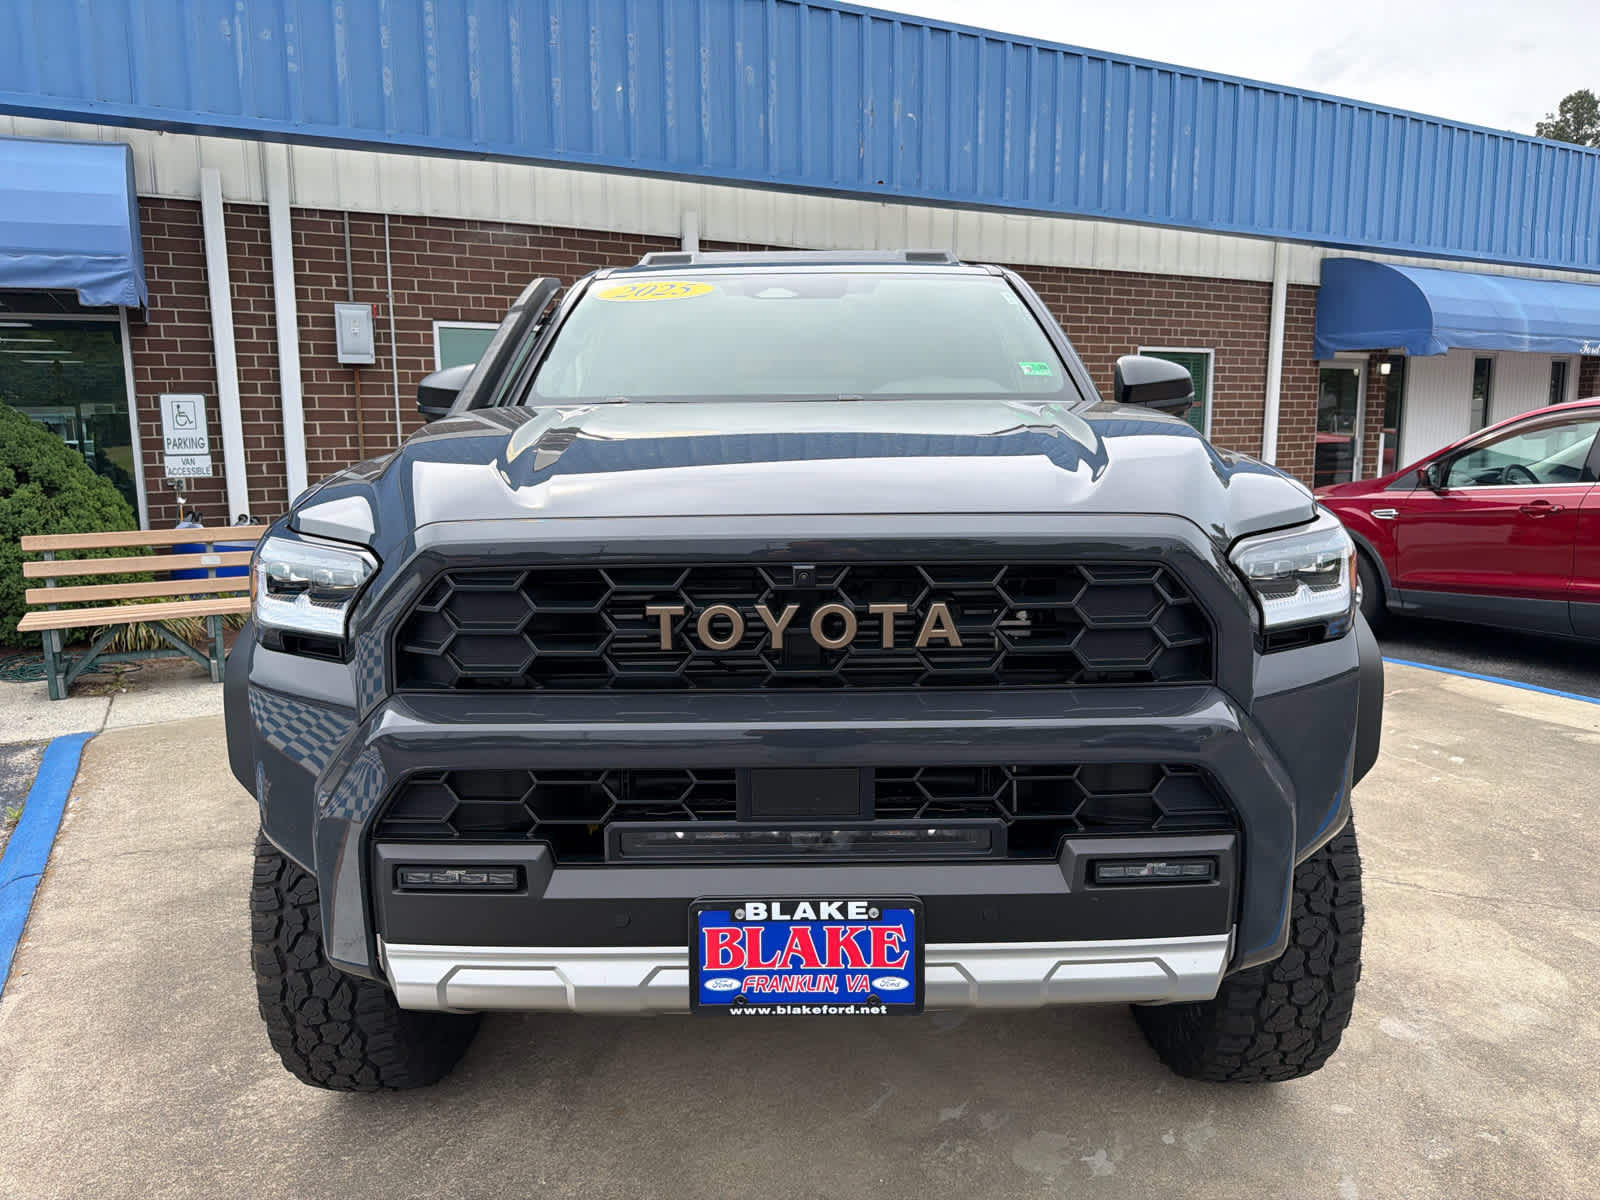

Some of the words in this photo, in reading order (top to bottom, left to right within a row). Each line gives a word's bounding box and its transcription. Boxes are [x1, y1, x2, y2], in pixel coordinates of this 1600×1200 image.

[615, 284, 694, 299] 2025
[166, 437, 206, 449] PARKING
[181, 457, 196, 466] VAN
[167, 467, 211, 475] ACCESSIBLE
[645, 602, 962, 650] TOYOTA
[745, 901, 869, 920] BLAKE
[702, 924, 909, 970] BLAKE
[711, 979, 734, 989] Ford
[742, 974, 839, 994] FRANKLIN,
[846, 974, 871, 992] VA
[880, 978, 902, 988] Ford
[730, 1005, 887, 1015] www.blakeford.net
